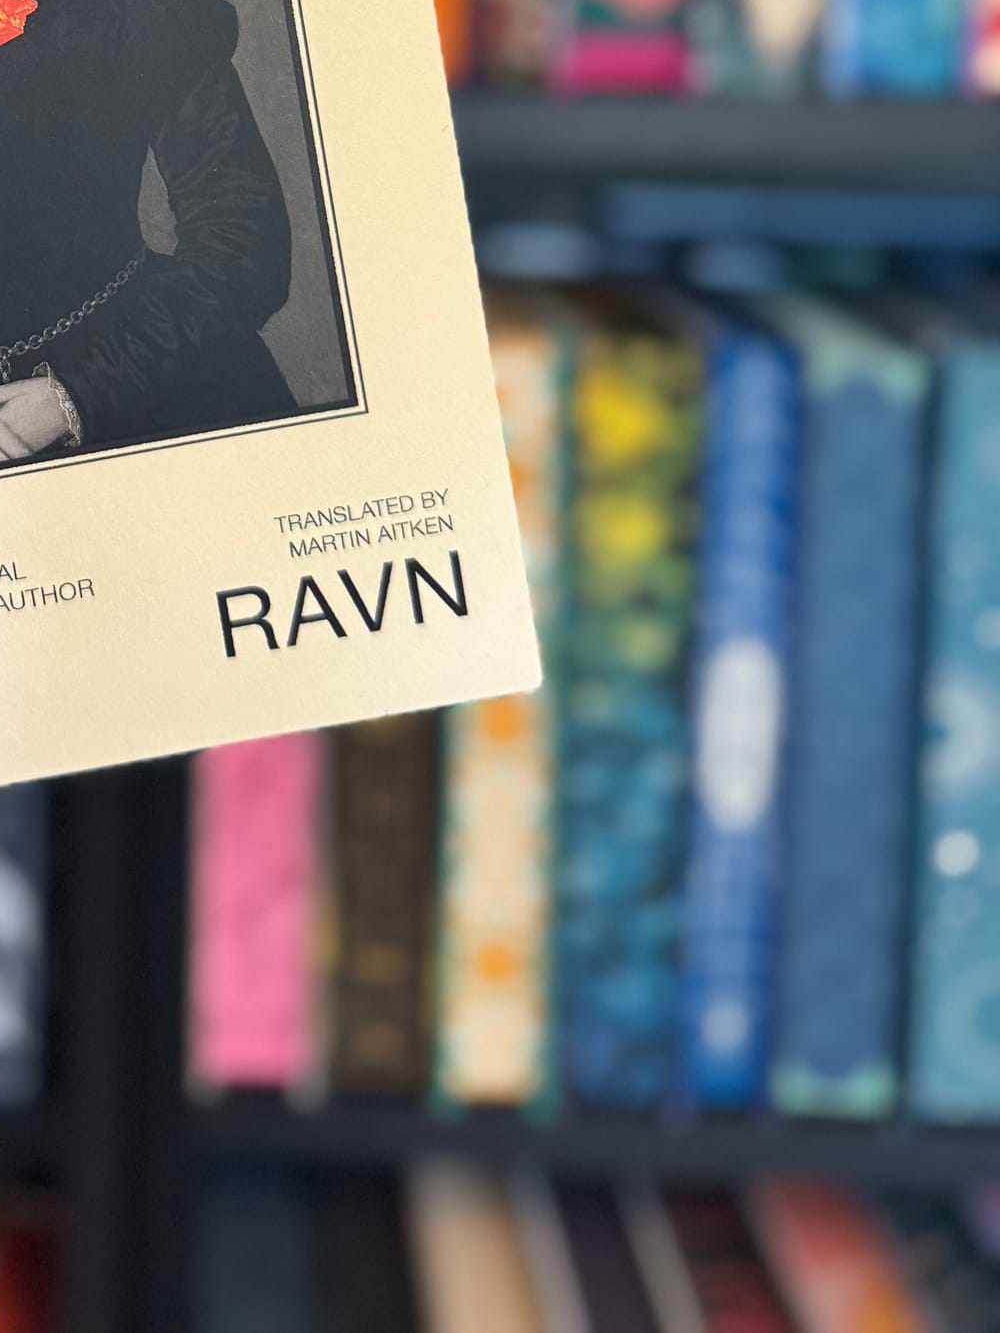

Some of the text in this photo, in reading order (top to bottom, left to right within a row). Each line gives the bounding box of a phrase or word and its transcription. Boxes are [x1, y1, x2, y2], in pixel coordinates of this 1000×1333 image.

[274, 488, 448, 534] TRANSLATED BY
[289, 515, 454, 558] MARTIN AITKEN
[216, 550, 468, 658] RAVN
